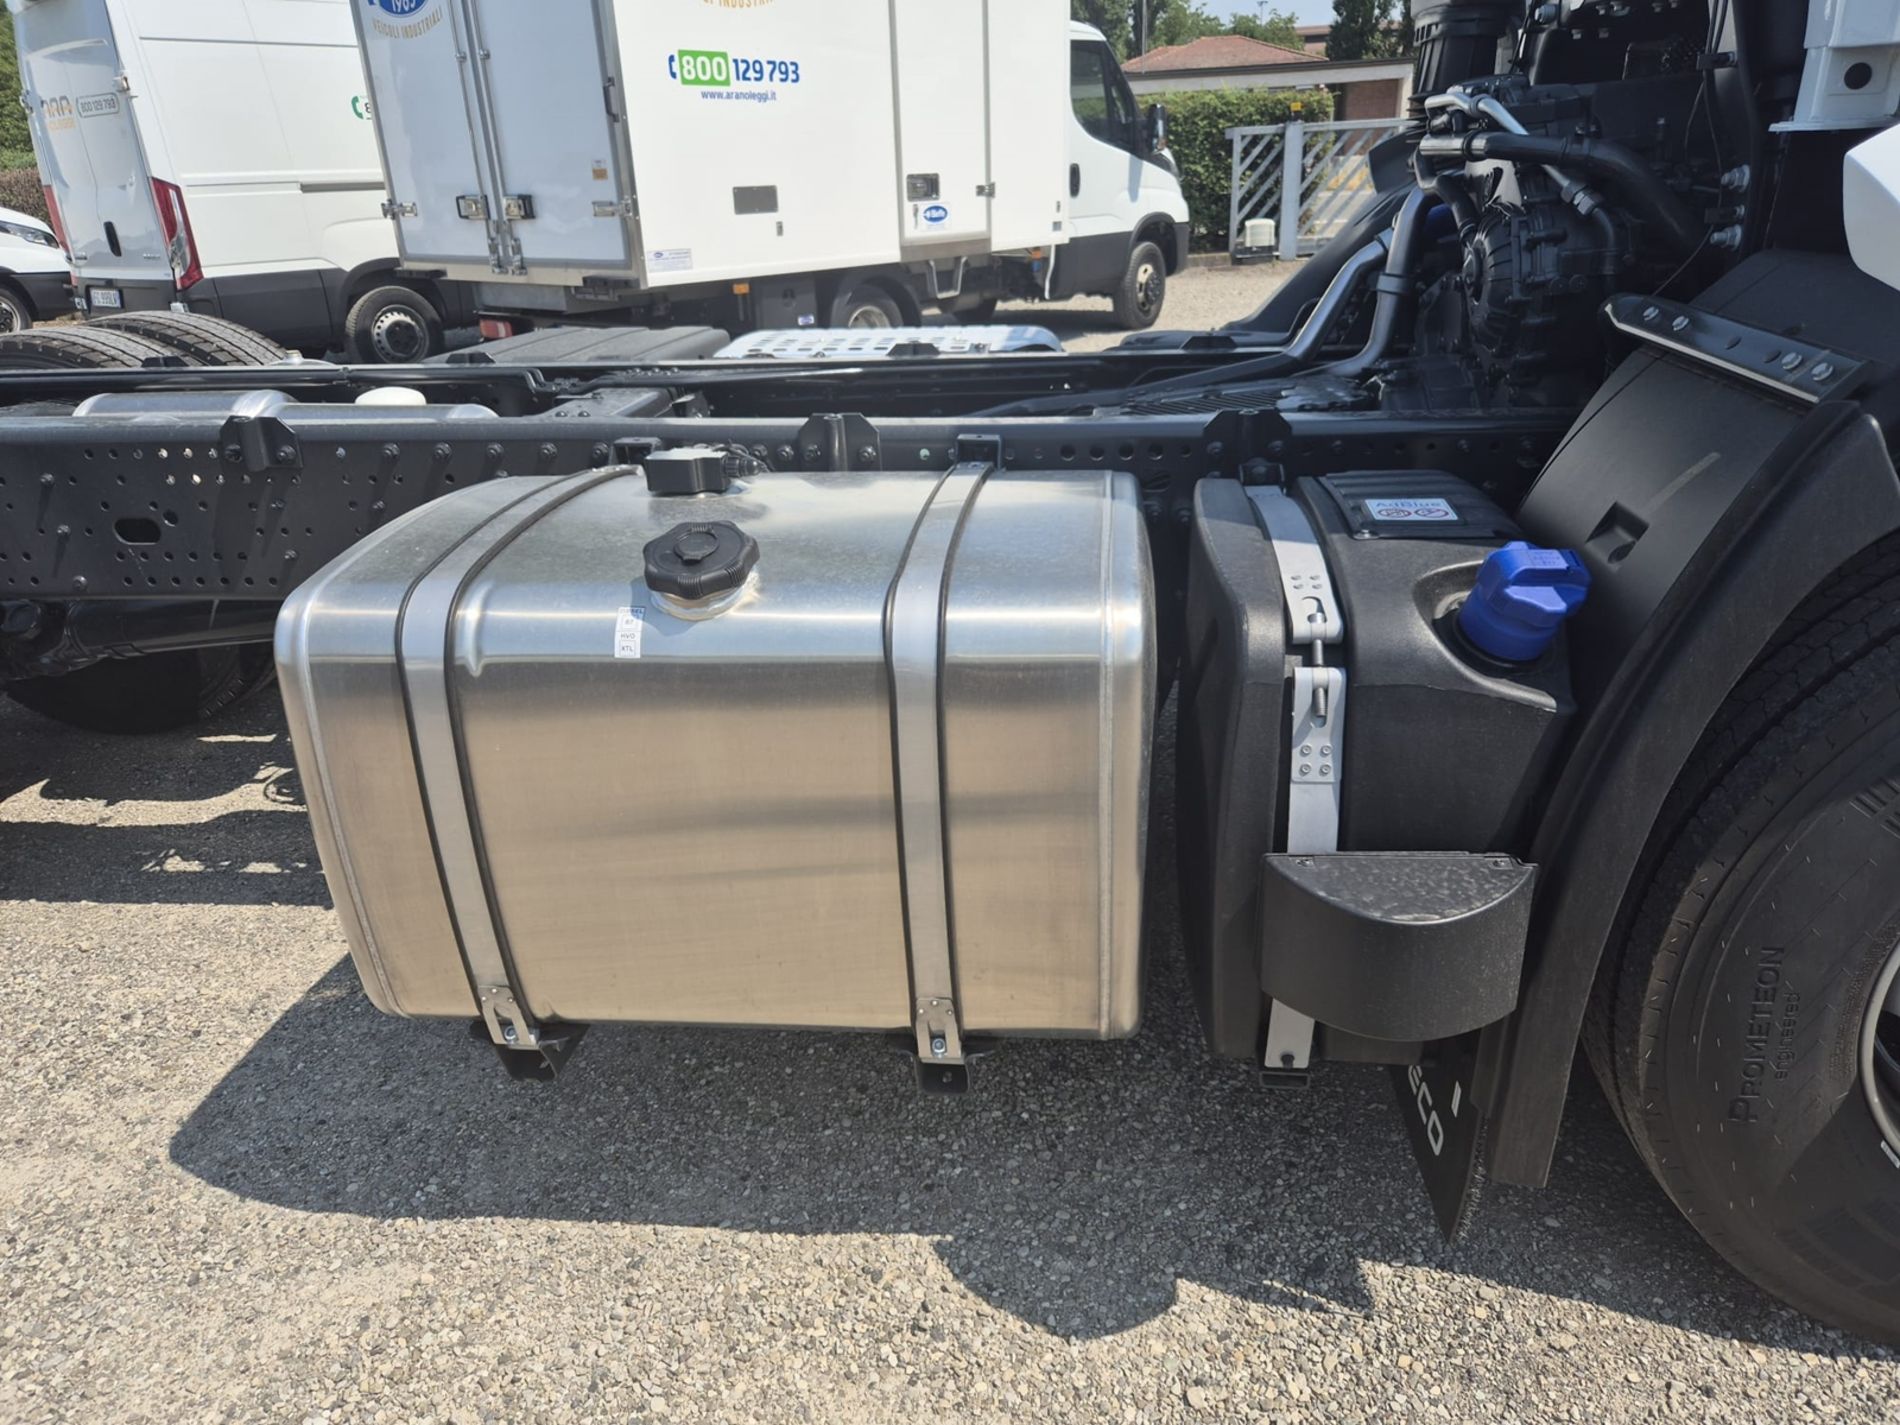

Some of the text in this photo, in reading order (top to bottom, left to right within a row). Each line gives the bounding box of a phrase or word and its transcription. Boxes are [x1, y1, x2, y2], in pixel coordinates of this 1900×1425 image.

[681, 55, 800, 83] 800 129 793
[700, 90, 777, 102] www.aranoleggi.it
[1728, 946, 1785, 1122] PROMETEON
[1775, 993, 1800, 1080] engineered
